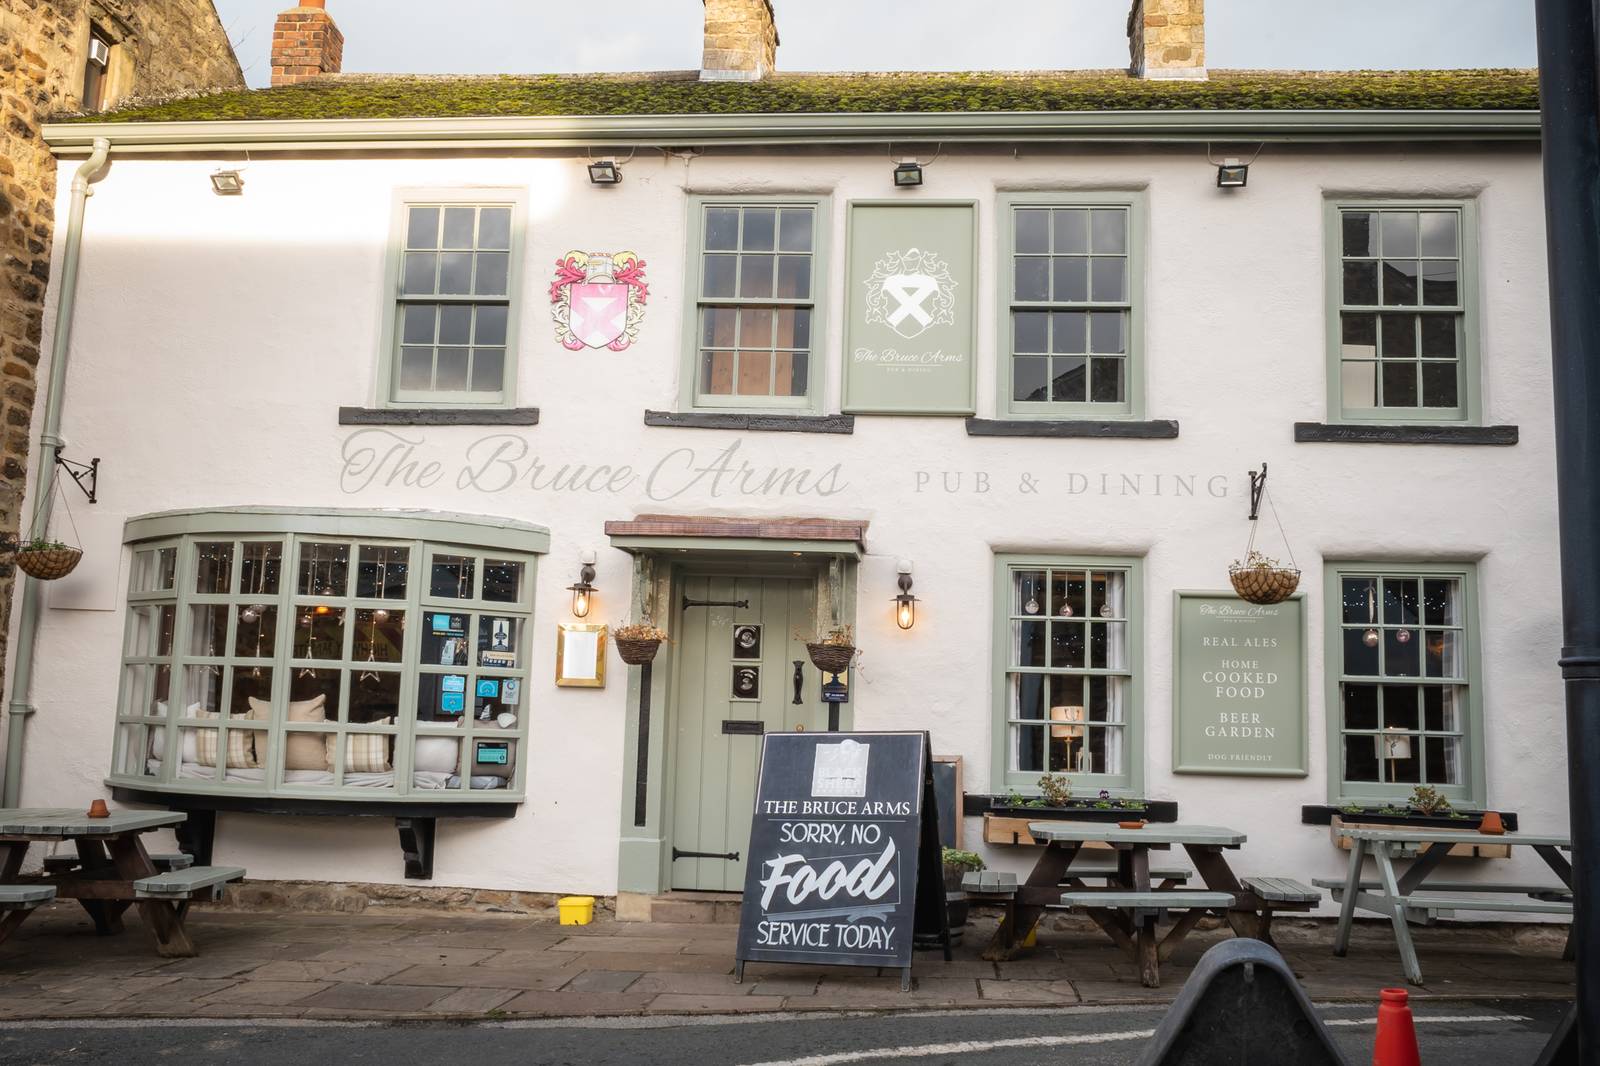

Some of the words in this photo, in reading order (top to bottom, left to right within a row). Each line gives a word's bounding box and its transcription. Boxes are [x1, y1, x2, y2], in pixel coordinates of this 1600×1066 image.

[854, 347, 878, 362] The
[880, 348, 919, 362] Bruce
[920, 349, 963, 363] Arms
[340, 428, 446, 494] The
[456, 433, 640, 493] Bruce
[645, 438, 850, 501] Arms
[914, 471, 991, 493] PUB
[1018, 472, 1040, 494] &
[1067, 473, 1228, 498] DINING
[1203, 637, 1237, 647] REAL
[1244, 638, 1278, 648] ALES
[1222, 660, 1259, 669] HOME
[1202, 671, 1279, 685] COOKED
[1216, 686, 1265, 698] FOOD
[1220, 712, 1261, 724] BEER
[1205, 726, 1275, 738] GARDEN
[1207, 753, 1227, 761] DOG
[1230, 753, 1273, 761] FRIENDLY
[764, 800, 798, 814] THE
[802, 801, 857, 815] BRUCE
[860, 801, 911, 816] ARMS
[779, 822, 846, 846] SORRY,
[851, 824, 881, 844] NO
[759, 836, 896, 911] Food
[756, 921, 831, 947] SERVICE
[834, 924, 896, 950] TODAY.
